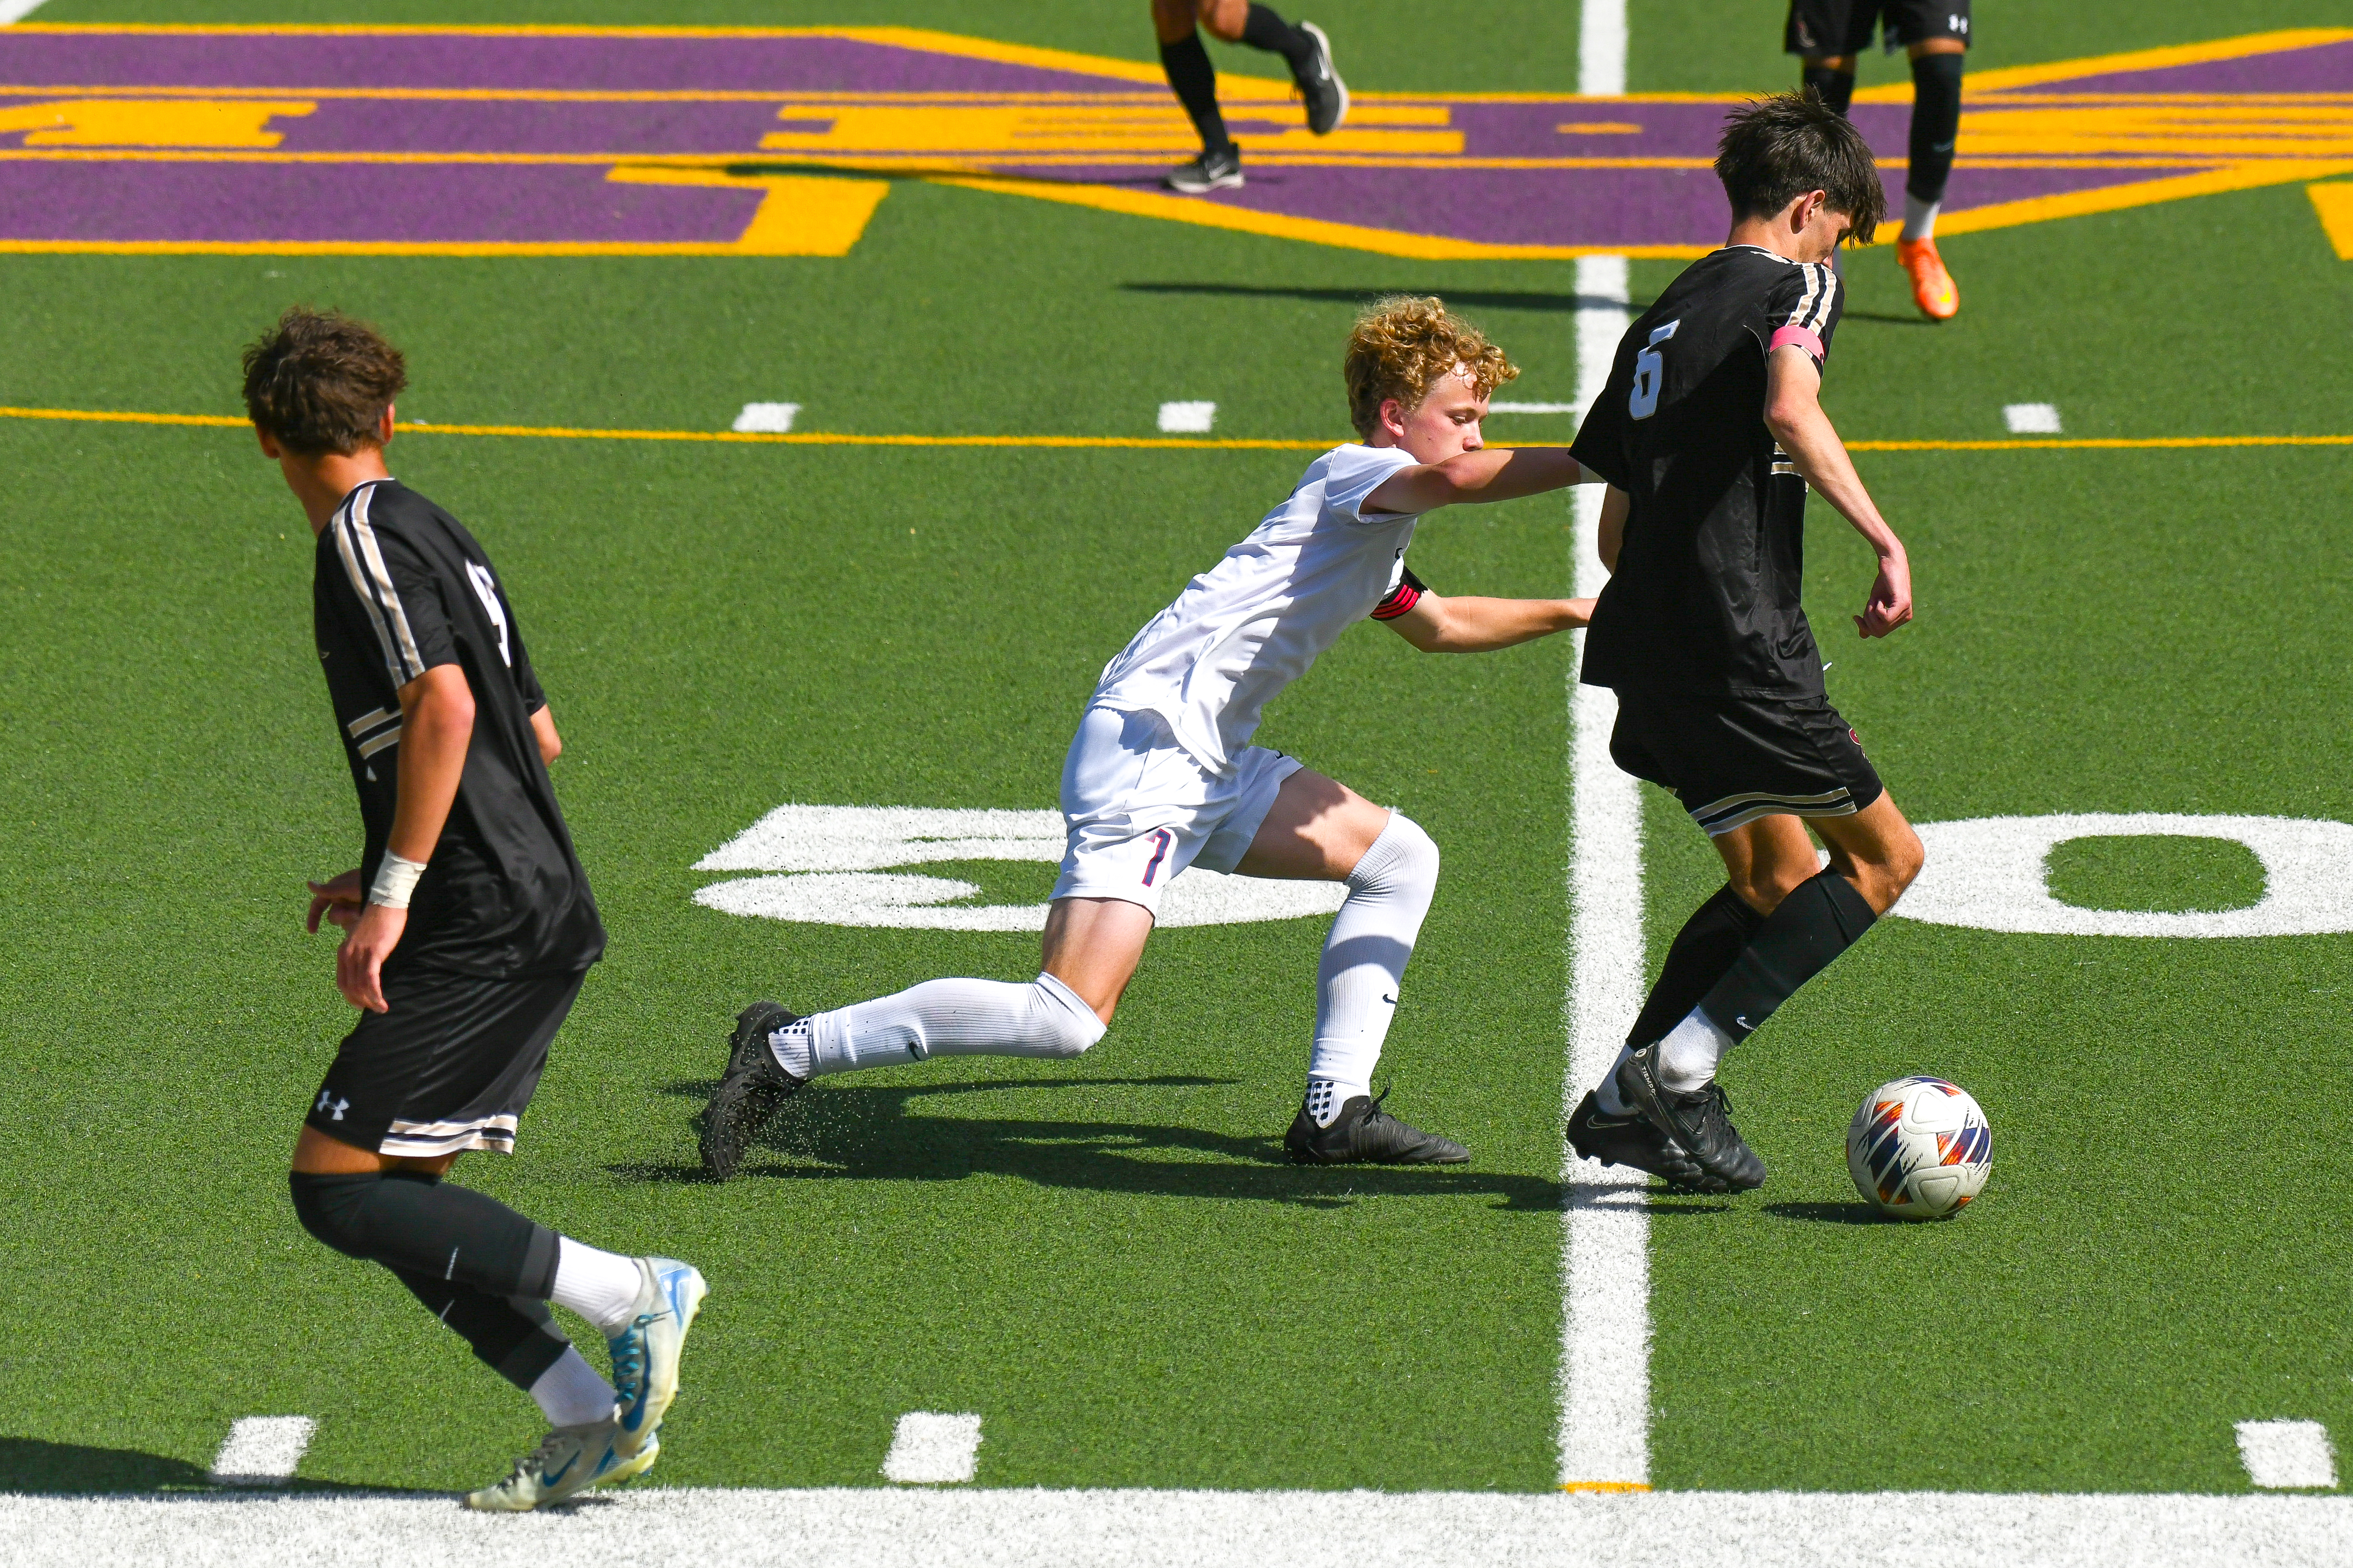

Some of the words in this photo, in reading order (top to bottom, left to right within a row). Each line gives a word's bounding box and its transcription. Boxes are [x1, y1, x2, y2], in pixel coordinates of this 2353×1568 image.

[1629, 318, 1681, 421] 6
[1141, 828, 1171, 887] 7
[1641, 1066, 1656, 1094] TIEMPO
